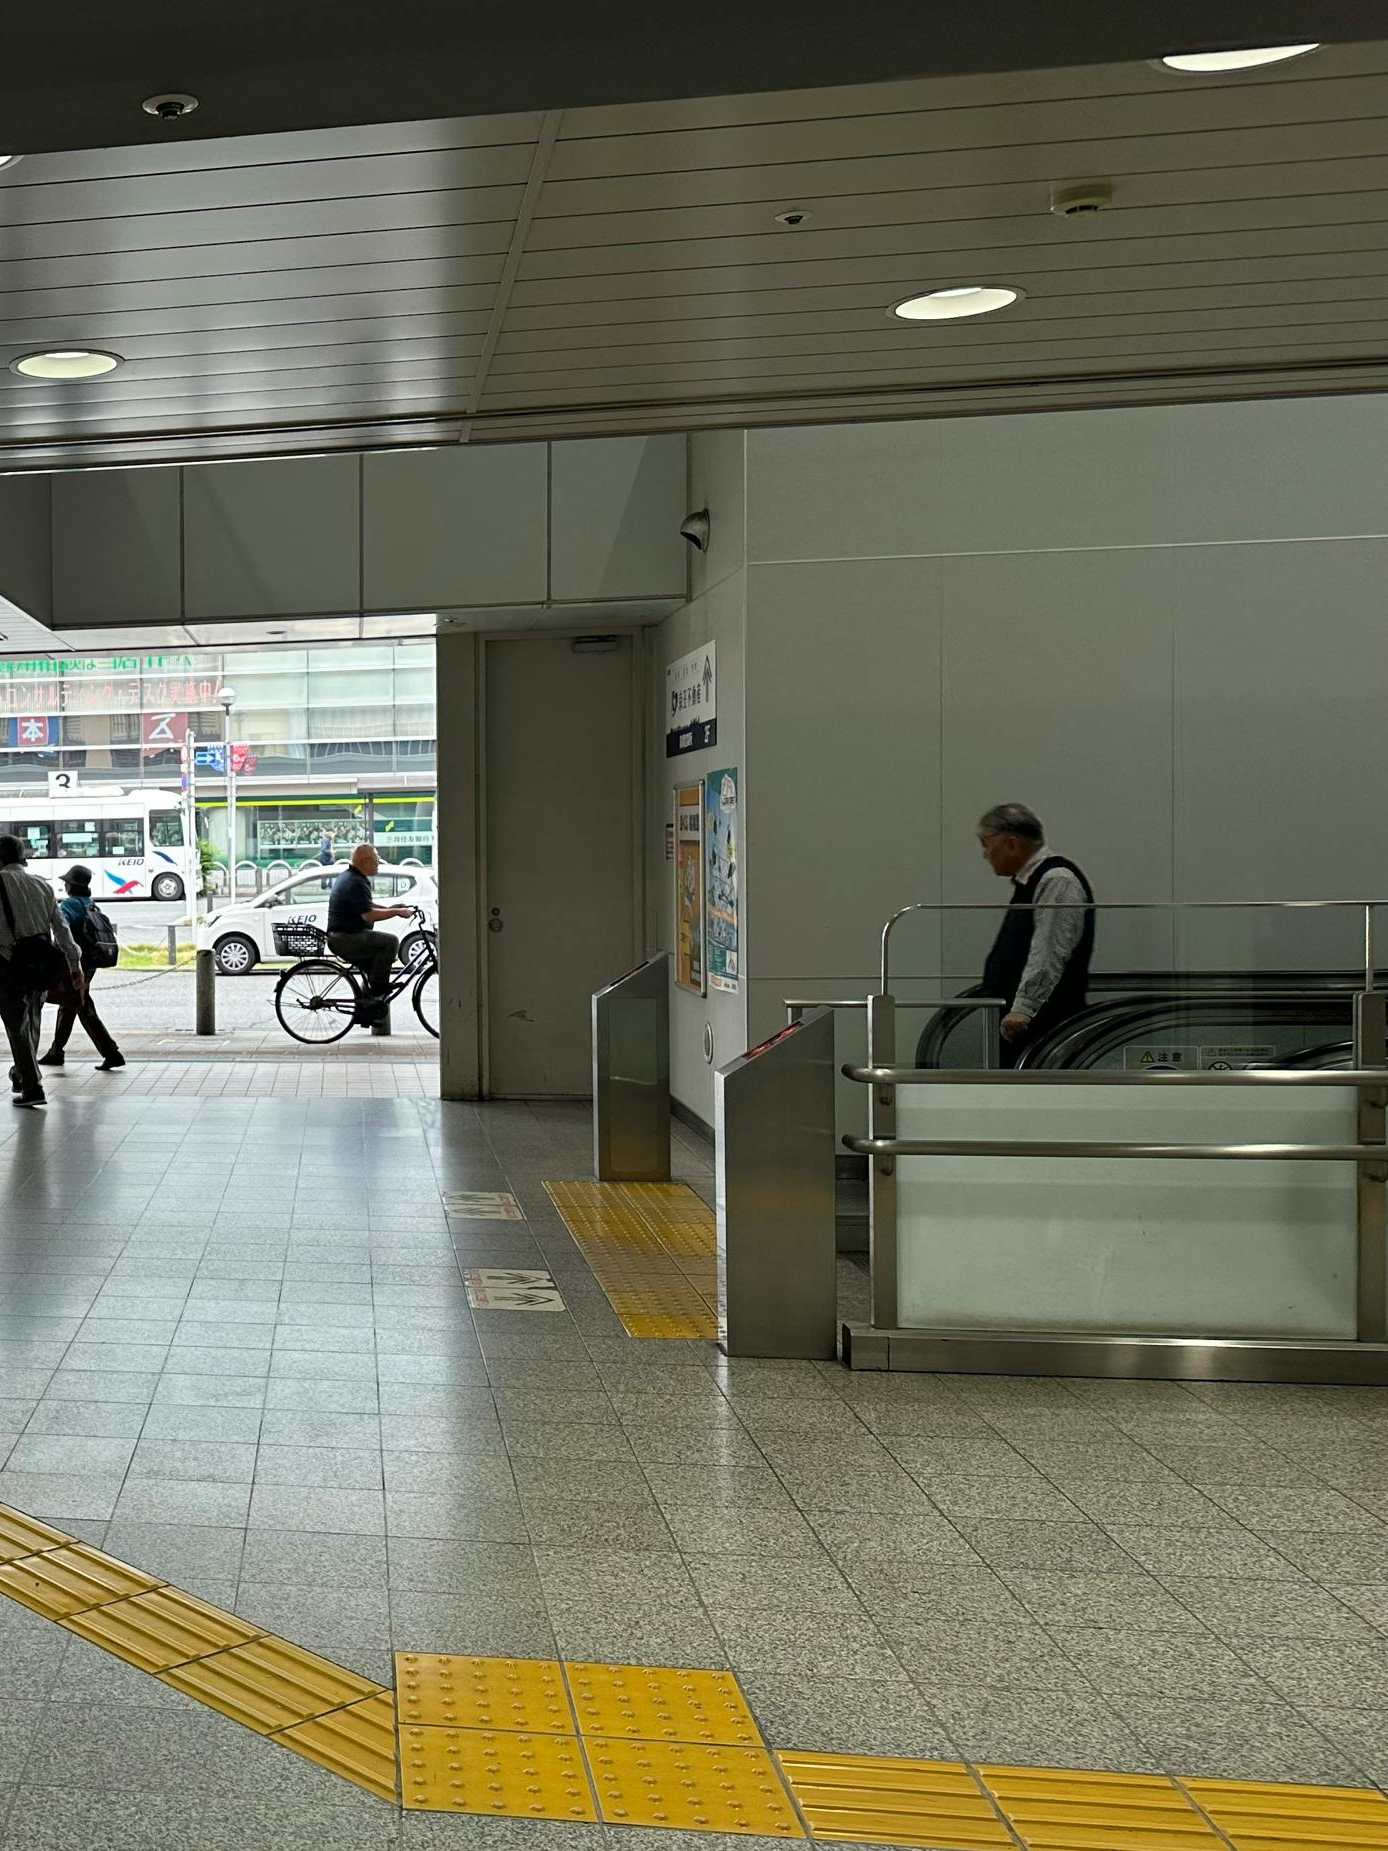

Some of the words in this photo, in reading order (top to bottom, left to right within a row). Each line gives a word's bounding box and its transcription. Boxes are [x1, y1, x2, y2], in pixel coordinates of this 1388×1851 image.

[21, 718, 44, 741] 本
[118, 858, 144, 866] KEIO
[1158, 1052, 1183, 1062] 注意
